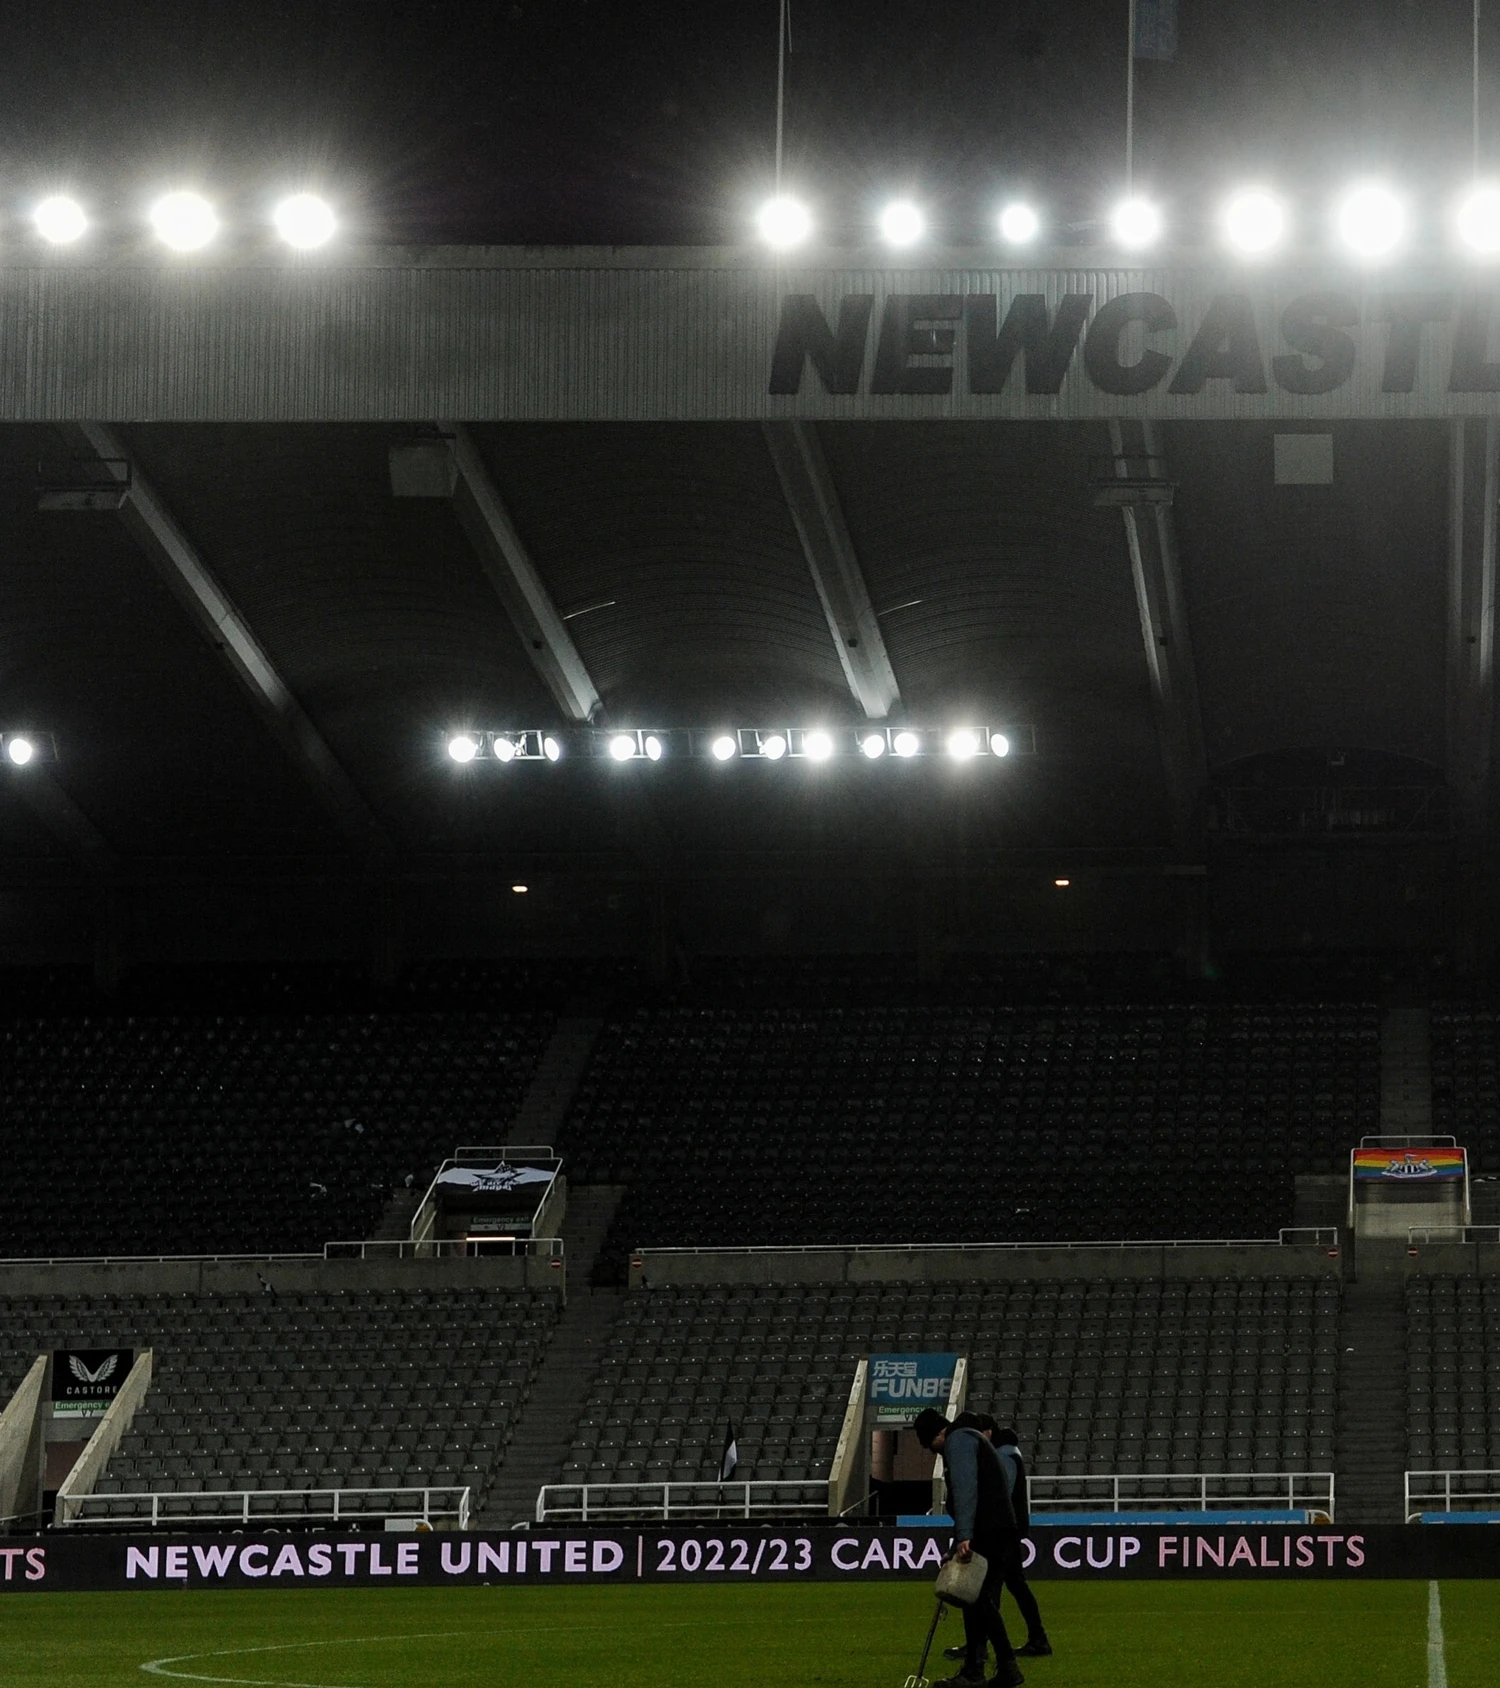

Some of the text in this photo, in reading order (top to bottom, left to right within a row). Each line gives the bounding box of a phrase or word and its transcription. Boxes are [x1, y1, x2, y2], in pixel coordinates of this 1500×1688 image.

[66, 1385, 118, 1395] CASTORE
[55, 1401, 102, 1411] Emergency
[126, 1542, 419, 1578] NEWCASTLE
[440, 1540, 624, 1574] UNITED
[656, 1538, 812, 1574] 2022/23
[1053, 1536, 1141, 1569] CUP
[1158, 1535, 1365, 1568] FINALISTS
